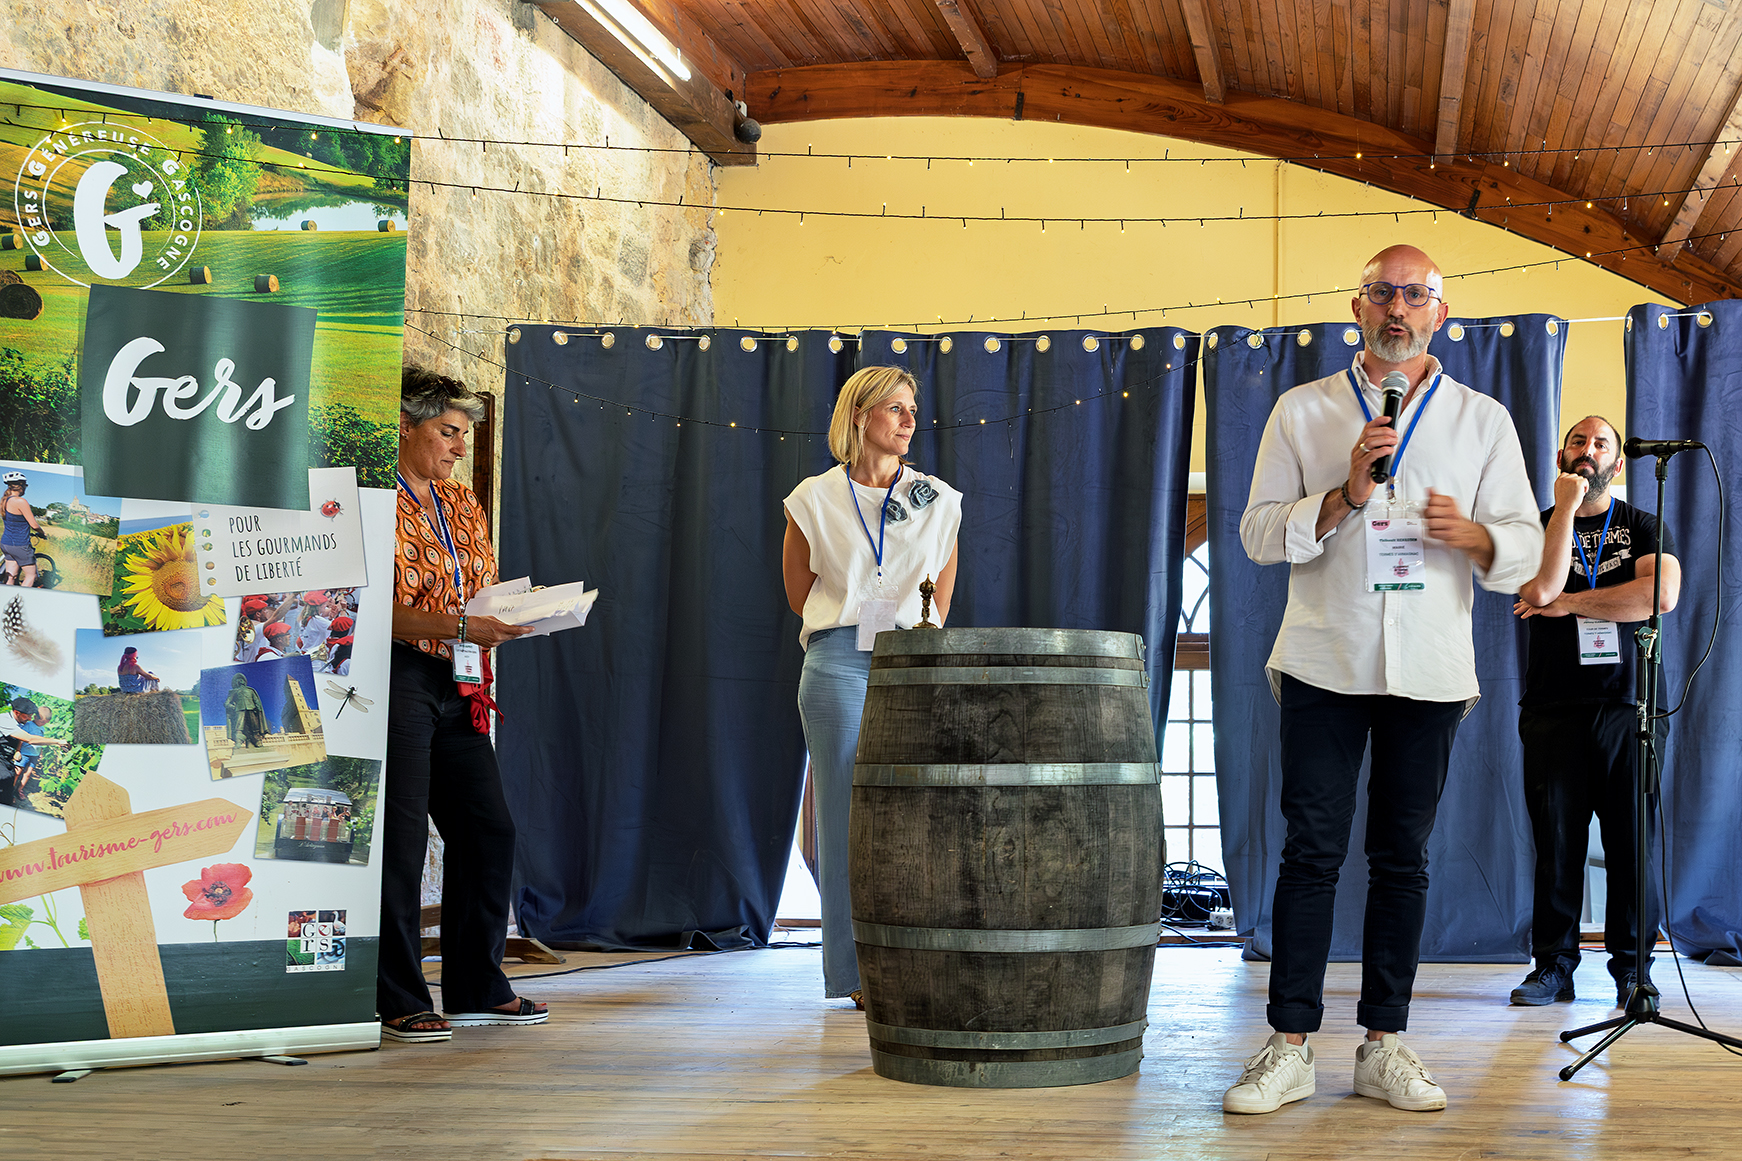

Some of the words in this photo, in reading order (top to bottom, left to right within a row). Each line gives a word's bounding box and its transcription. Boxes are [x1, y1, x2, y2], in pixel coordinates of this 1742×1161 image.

[24, 189, 51, 247] GERS
[162, 159, 194, 270] GASCOGNE
[102, 336, 296, 431] Gers
[228, 514, 262, 534] POUR
[231, 539, 253, 558] LES
[256, 532, 338, 557] GOURMANDS
[235, 564, 251, 582] DE
[255, 556, 303, 581] LIBERTÉ
